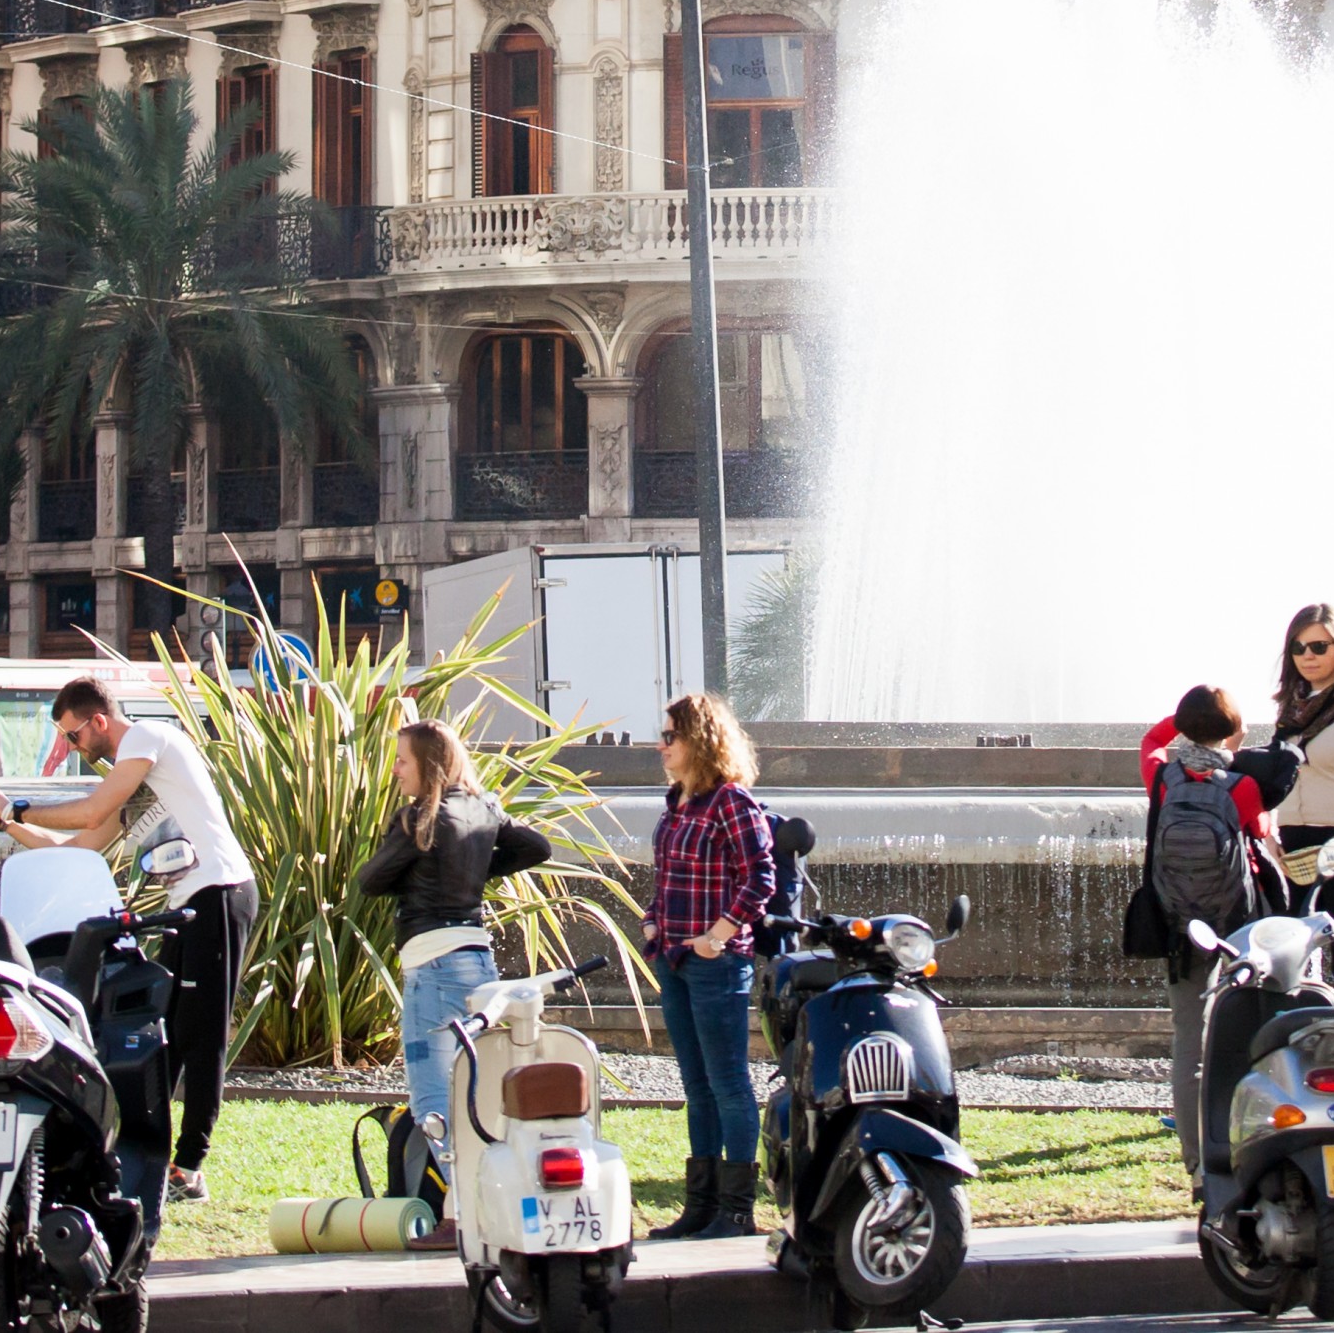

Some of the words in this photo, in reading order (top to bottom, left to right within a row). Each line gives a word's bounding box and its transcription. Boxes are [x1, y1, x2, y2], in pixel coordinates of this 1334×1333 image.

[540, 1199, 553, 1220] V
[574, 1195, 601, 1218] AL
[543, 1219, 603, 1247] 2778
